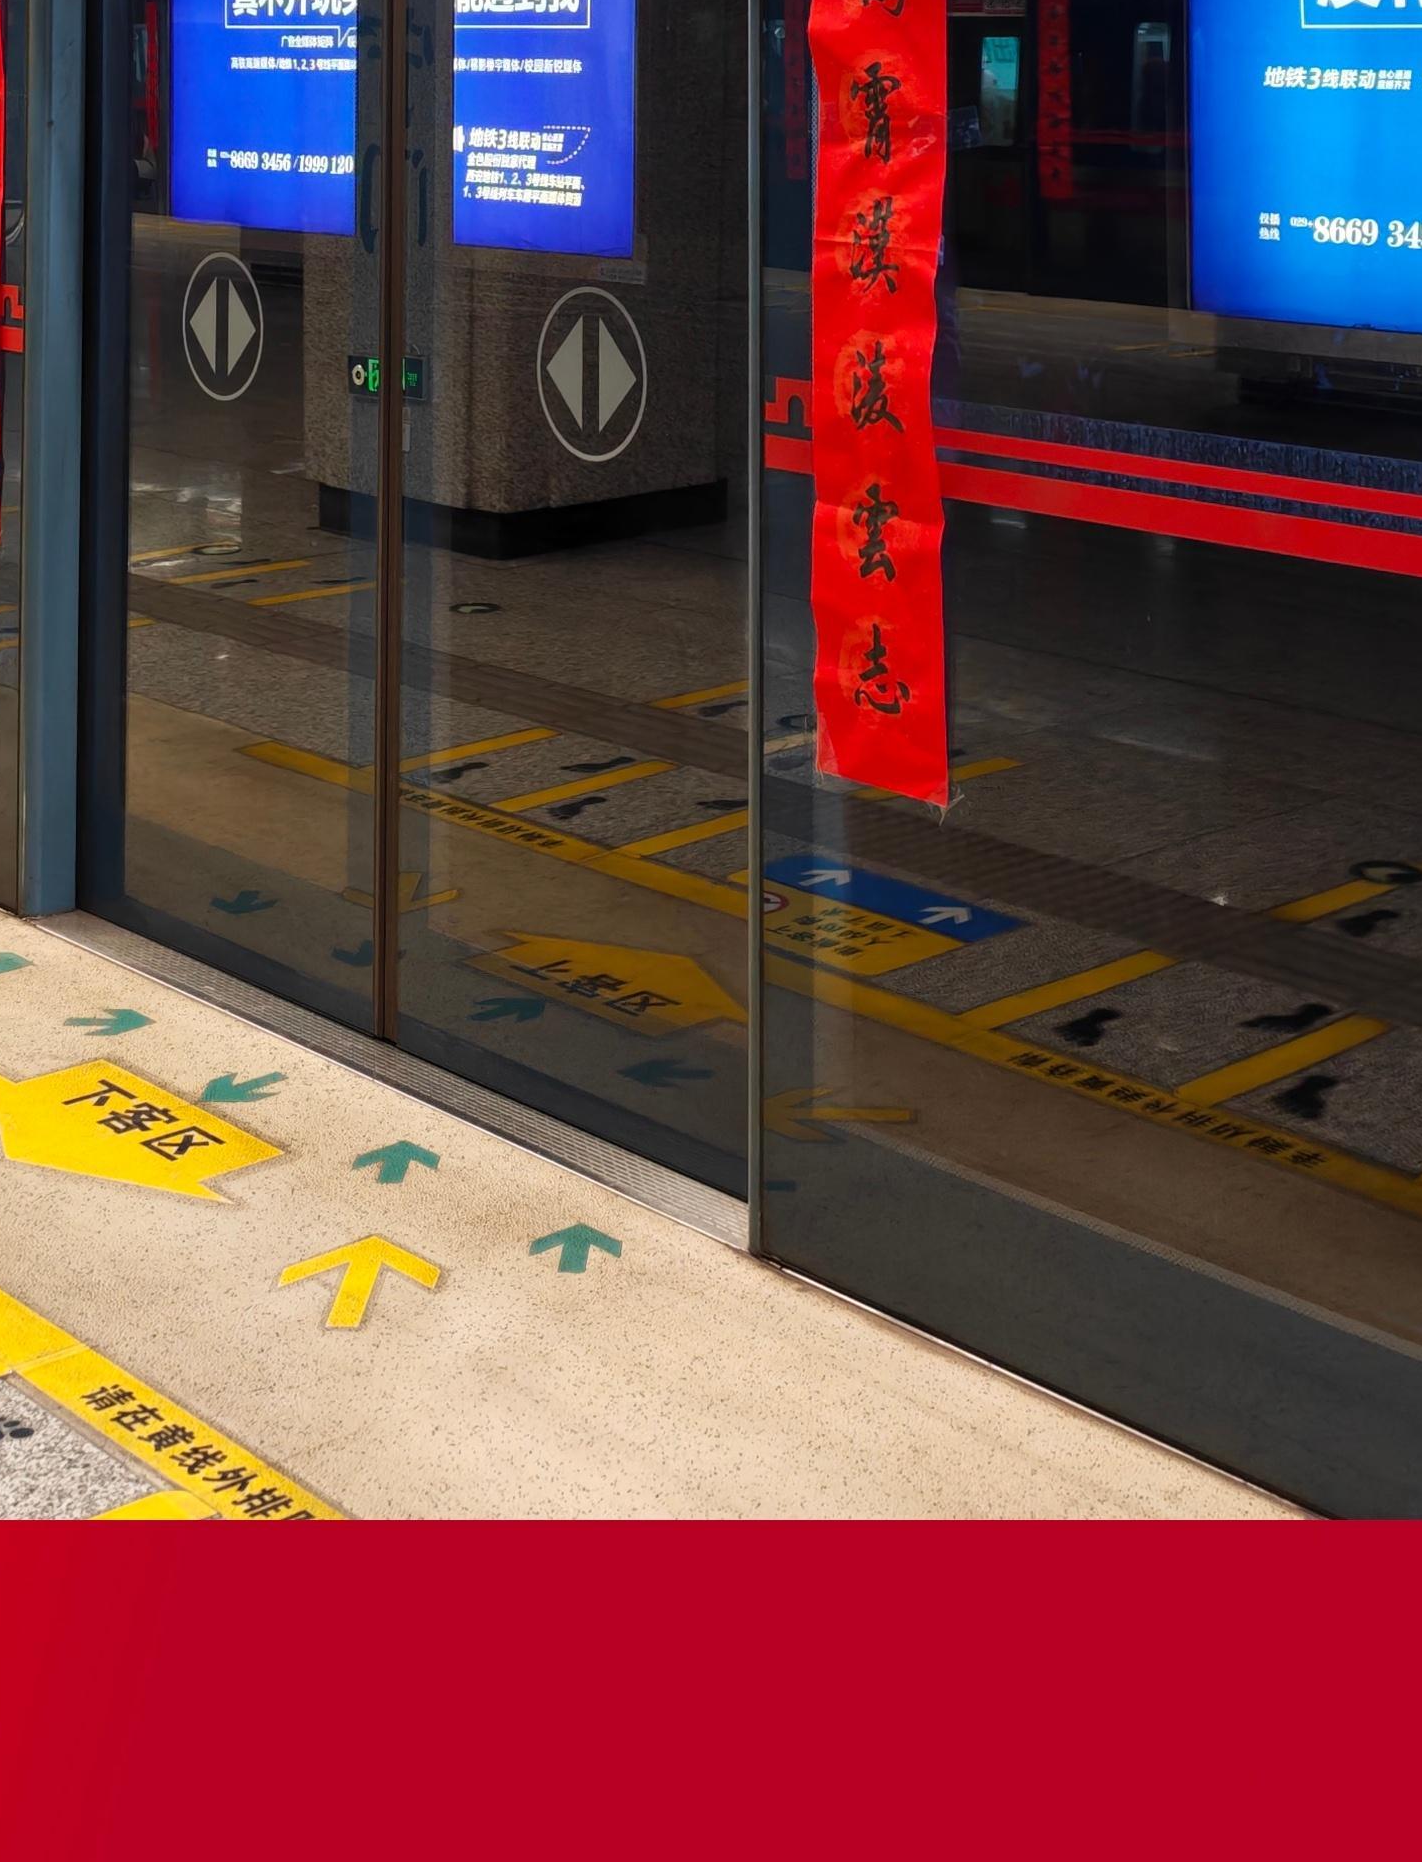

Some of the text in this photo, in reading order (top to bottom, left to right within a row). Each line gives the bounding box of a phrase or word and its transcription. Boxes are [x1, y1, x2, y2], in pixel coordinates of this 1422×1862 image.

[1263, 65, 1377, 91] 地铁3线联动
[261, 151, 291, 172] 3456
[330, 155, 354, 175] 120
[61, 1078, 227, 1164] 下客区
